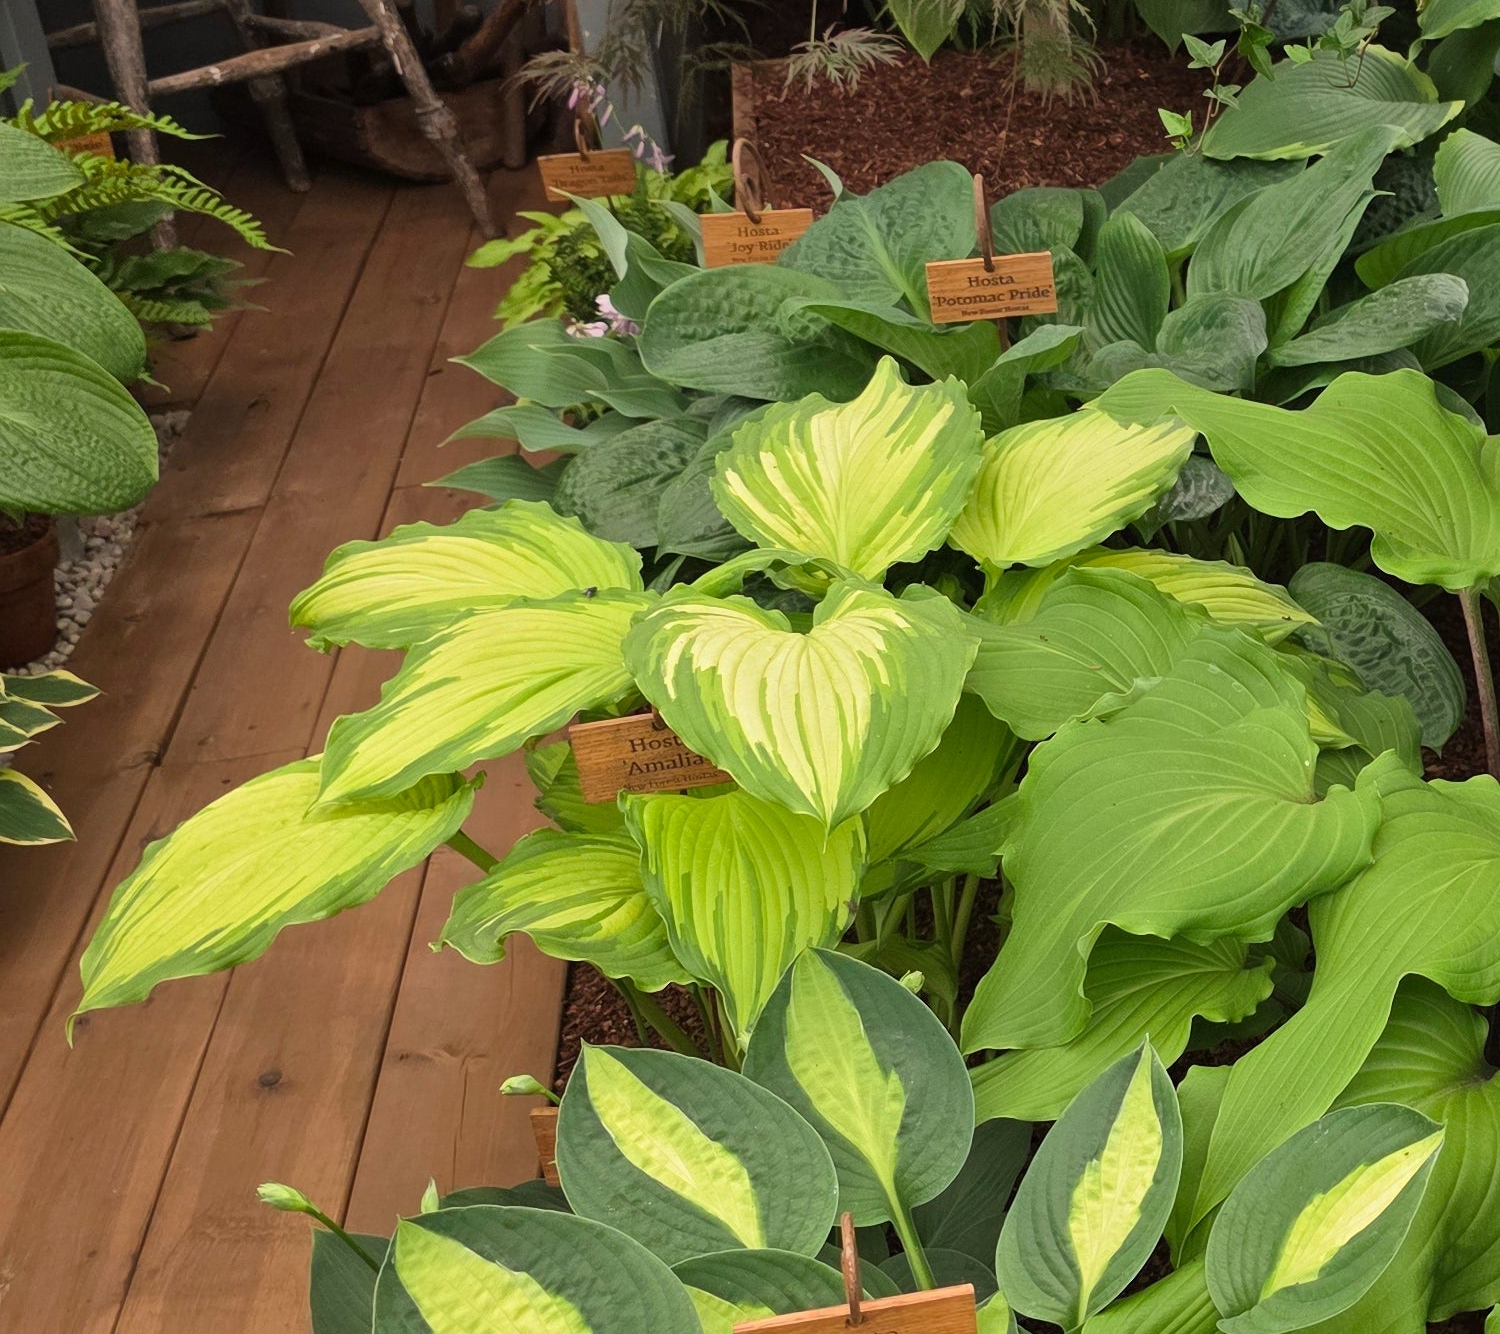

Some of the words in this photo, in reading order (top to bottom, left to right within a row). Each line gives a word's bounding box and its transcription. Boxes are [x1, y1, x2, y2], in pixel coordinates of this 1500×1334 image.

[738, 227, 781, 238] Hosta
[967, 275, 1015, 288] Hosta
[932, 292, 1006, 308] 'Potomac
[1008, 284, 1053, 301] Pride'
[628, 735, 683, 754] Host
[622, 752, 705, 777] 'Amalia
